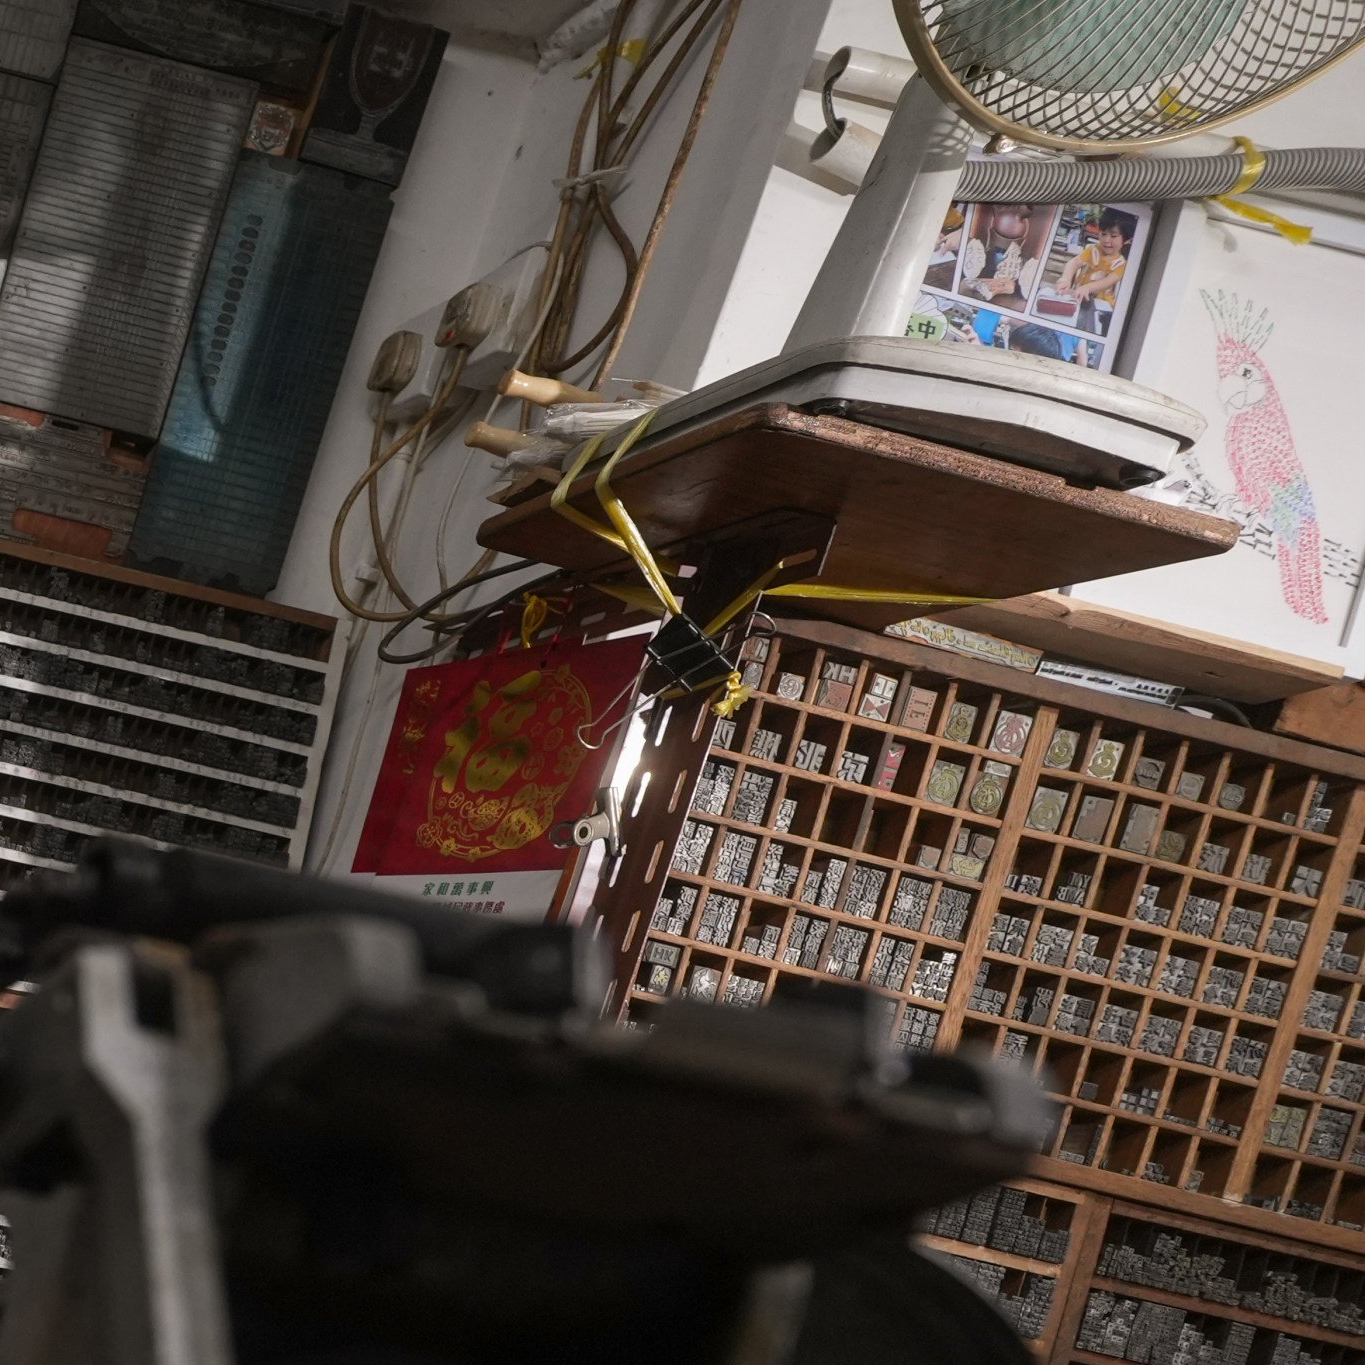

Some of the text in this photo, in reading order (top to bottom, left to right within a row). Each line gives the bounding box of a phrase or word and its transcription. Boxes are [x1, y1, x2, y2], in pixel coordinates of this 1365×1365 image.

[421, 880, 495, 896] 家和萬事興
